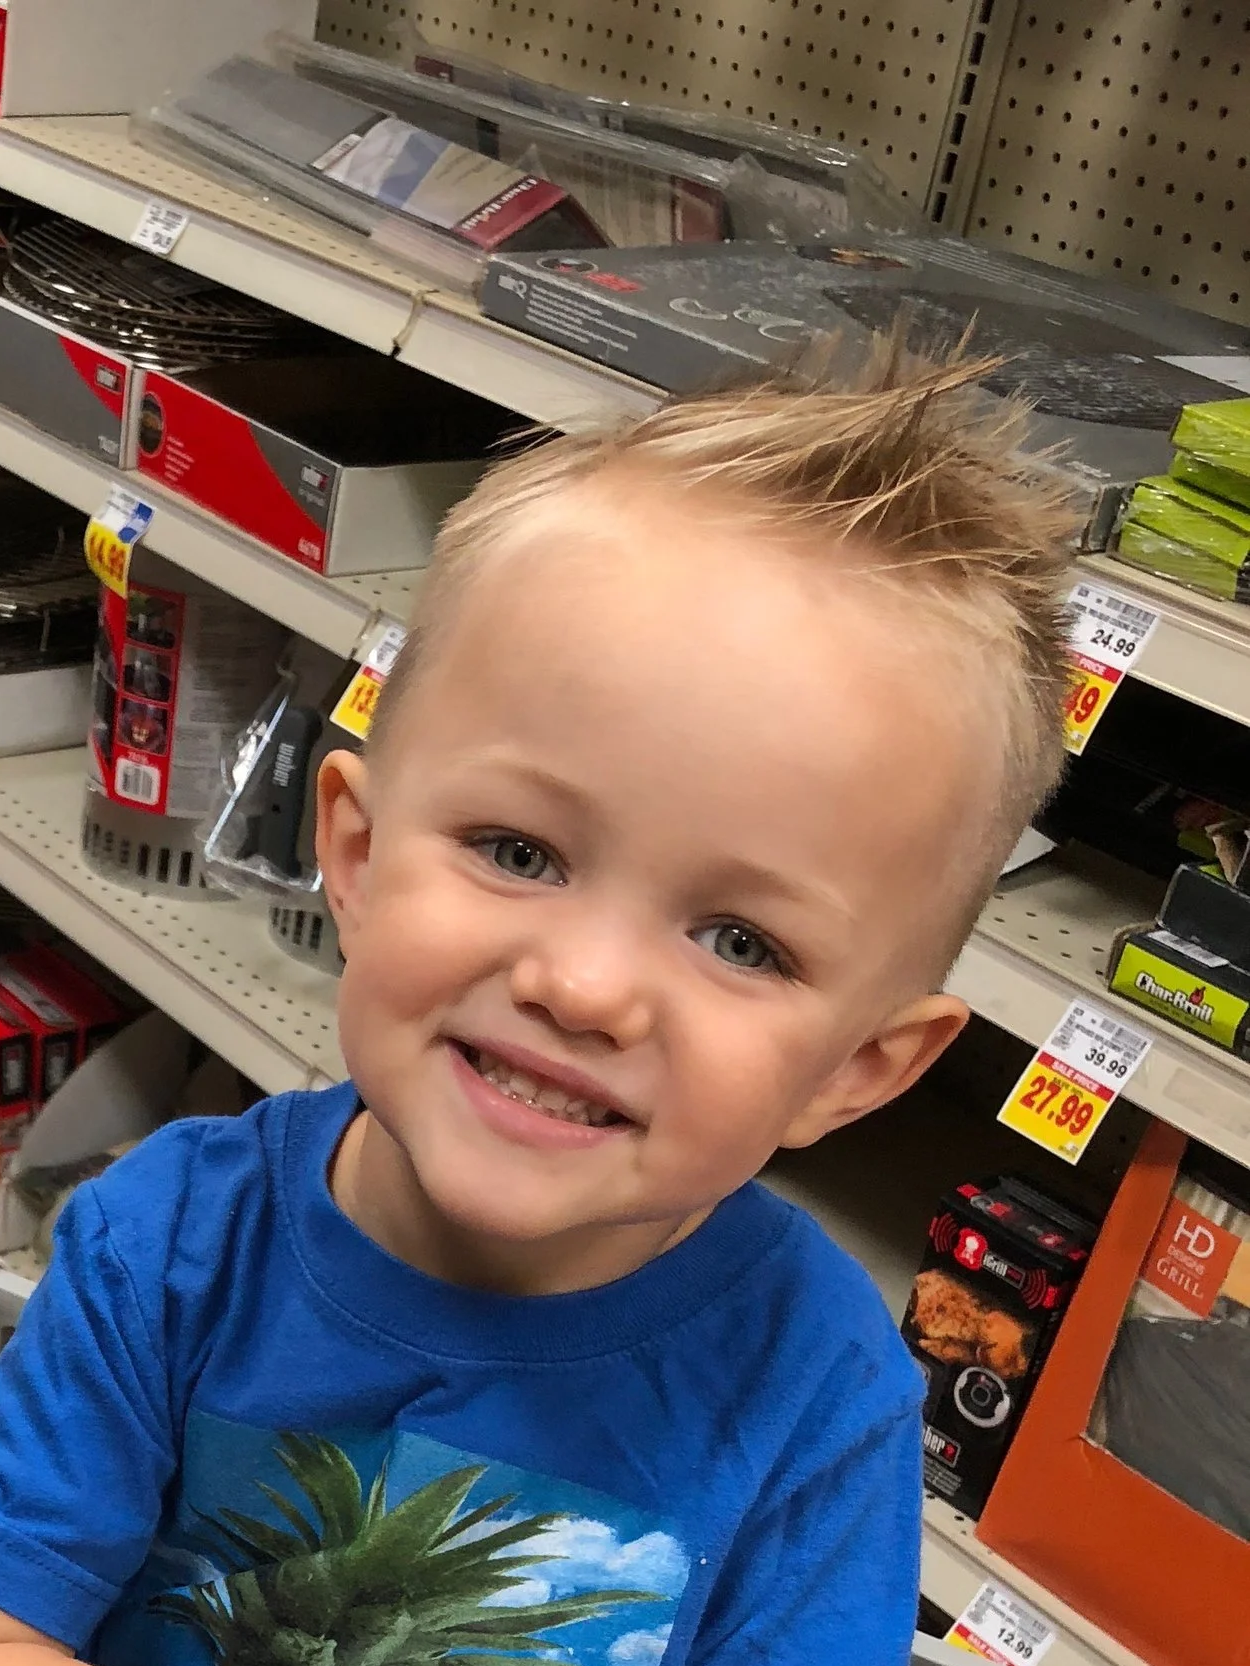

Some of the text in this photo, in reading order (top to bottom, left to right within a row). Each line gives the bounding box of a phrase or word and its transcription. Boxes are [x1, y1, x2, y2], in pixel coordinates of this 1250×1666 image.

[1090, 628, 1136, 658] 24.99
[1085, 1048, 1128, 1079] 39.99
[1019, 1075, 1094, 1136] 27.99
[1173, 1215, 1215, 1259] HD
[1156, 1258, 1205, 1299] GRILL
[997, 1627, 1033, 1660] 12.99
